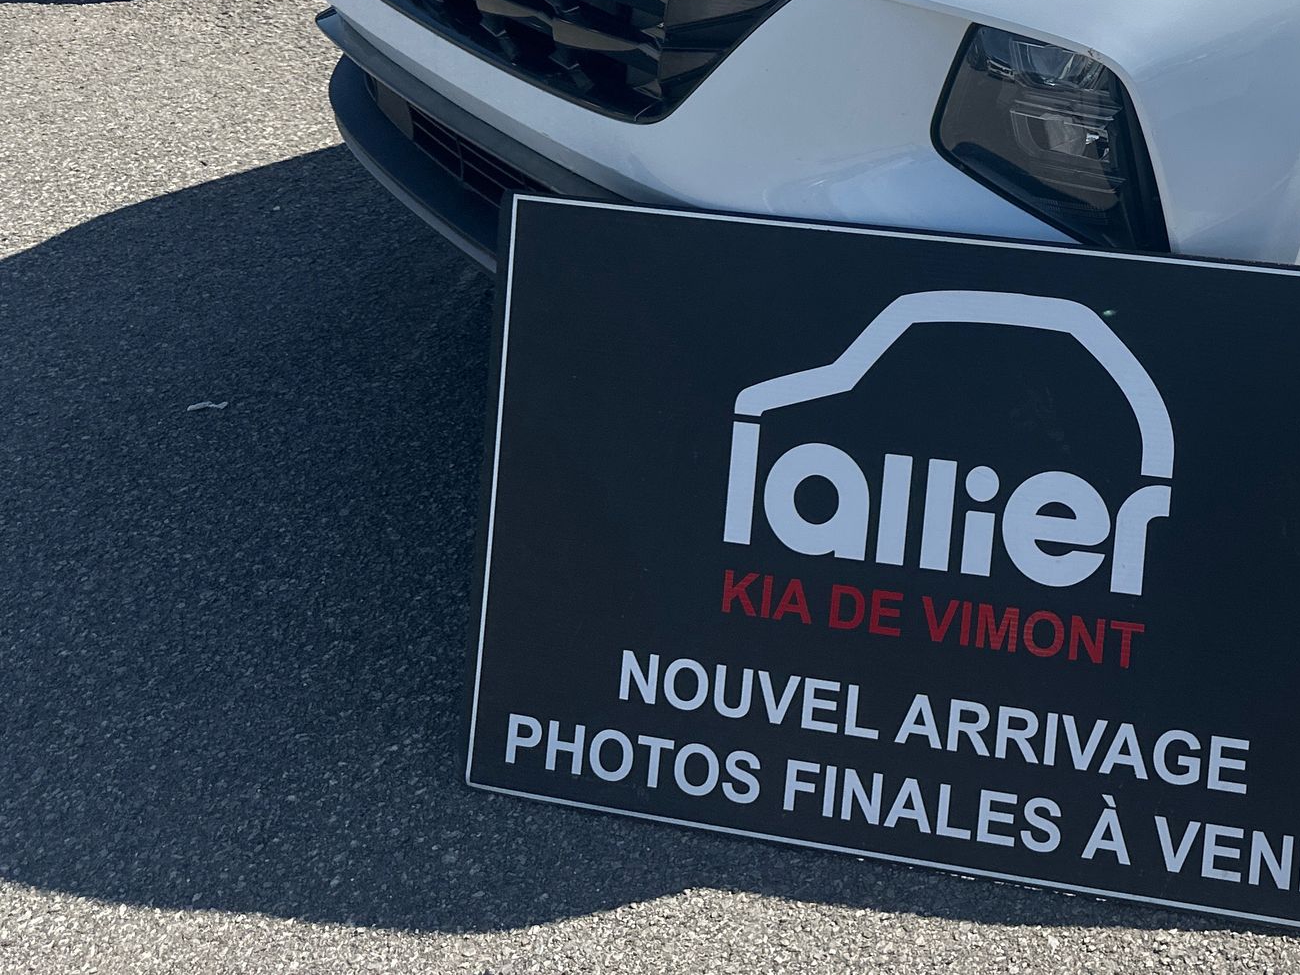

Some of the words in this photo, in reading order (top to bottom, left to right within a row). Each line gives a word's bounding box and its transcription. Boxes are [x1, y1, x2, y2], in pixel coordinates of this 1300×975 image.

[721, 569, 812, 625] KIA
[828, 584, 904, 637] DE
[921, 595, 1146, 669] VIMONT
[504, 712, 761, 804] PHOTOS
[783, 759, 1062, 853] FINALES
[1081, 793, 1131, 866] À
[618, 649, 879, 740] NOUVEL
[894, 693, 1251, 795] ARRIVAGE
